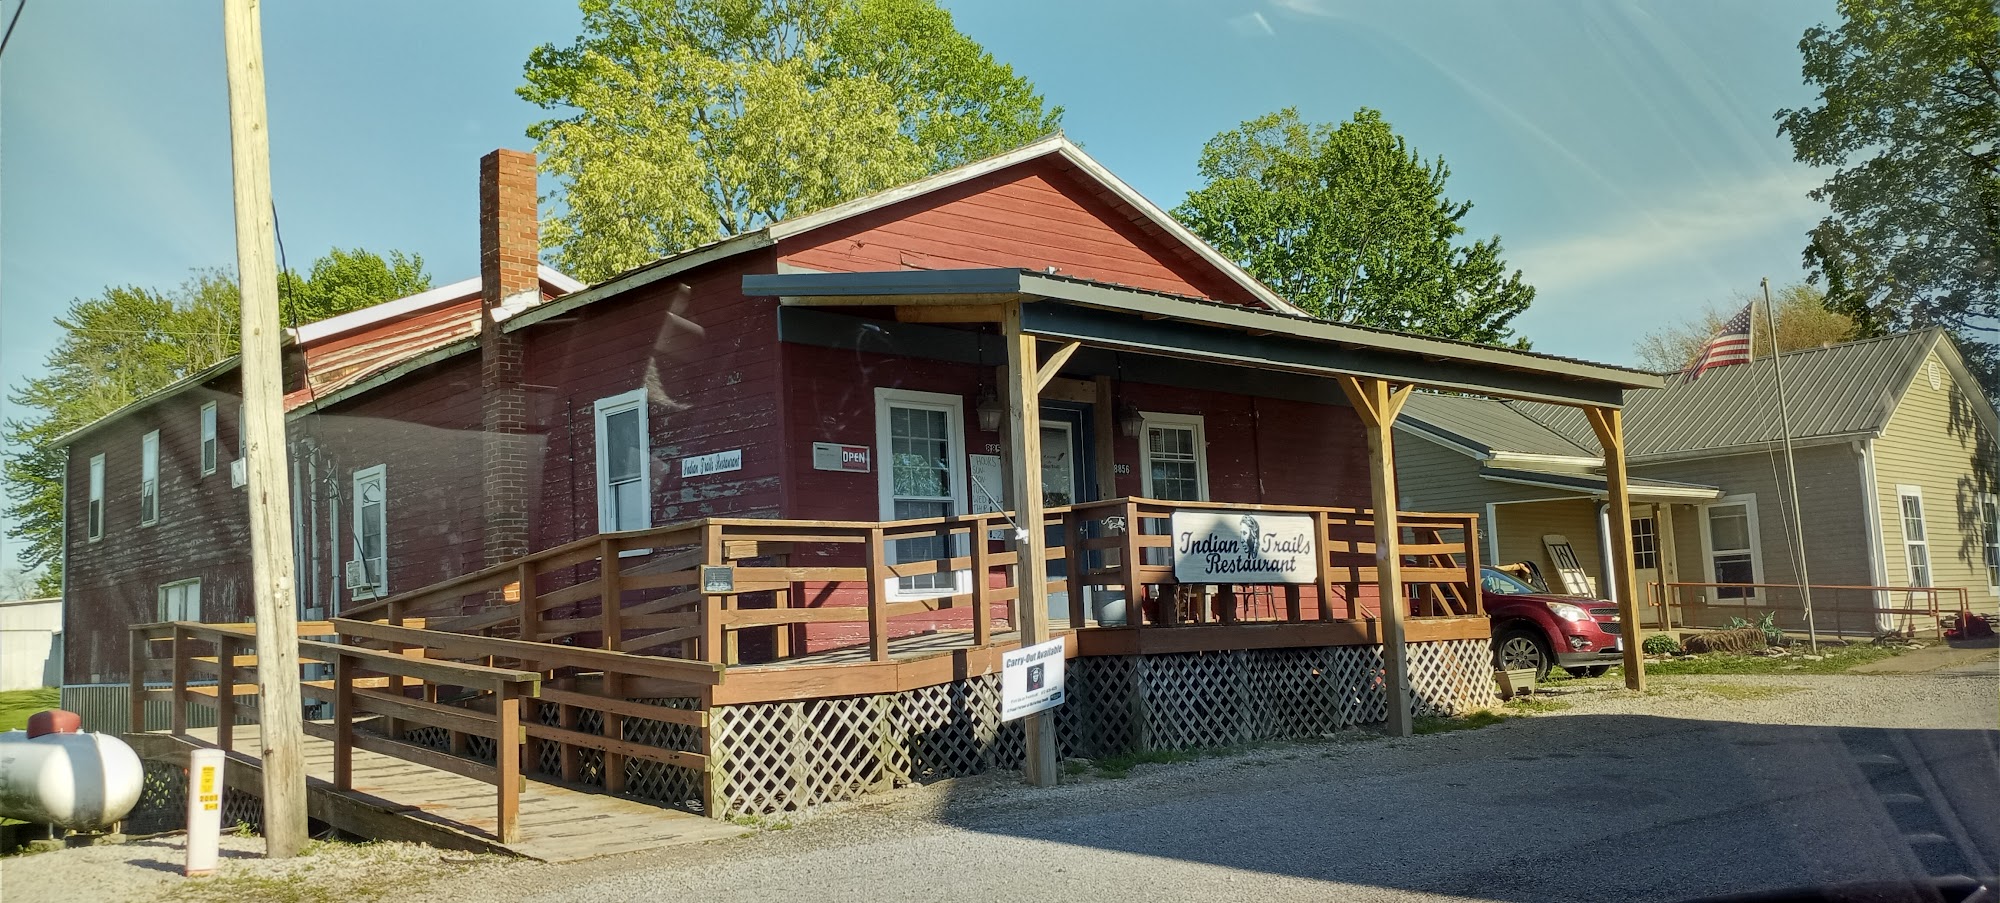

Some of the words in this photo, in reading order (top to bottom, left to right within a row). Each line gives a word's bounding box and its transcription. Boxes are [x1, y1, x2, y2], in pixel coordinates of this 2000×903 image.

[985, 444, 1000, 453] 885
[715, 453, 740, 471] Restaurant
[843, 451, 865, 464] OPEN
[976, 457, 997, 467] HOURS
[1113, 464, 1130, 474] 8856
[1180, 532, 1240, 555] Indian
[1262, 533, 1311, 555] Trails
[1205, 552, 1297, 574] Restaurant
[1006, 653, 1036, 668] Carry-Out
[1037, 645, 1062, 660] Available
